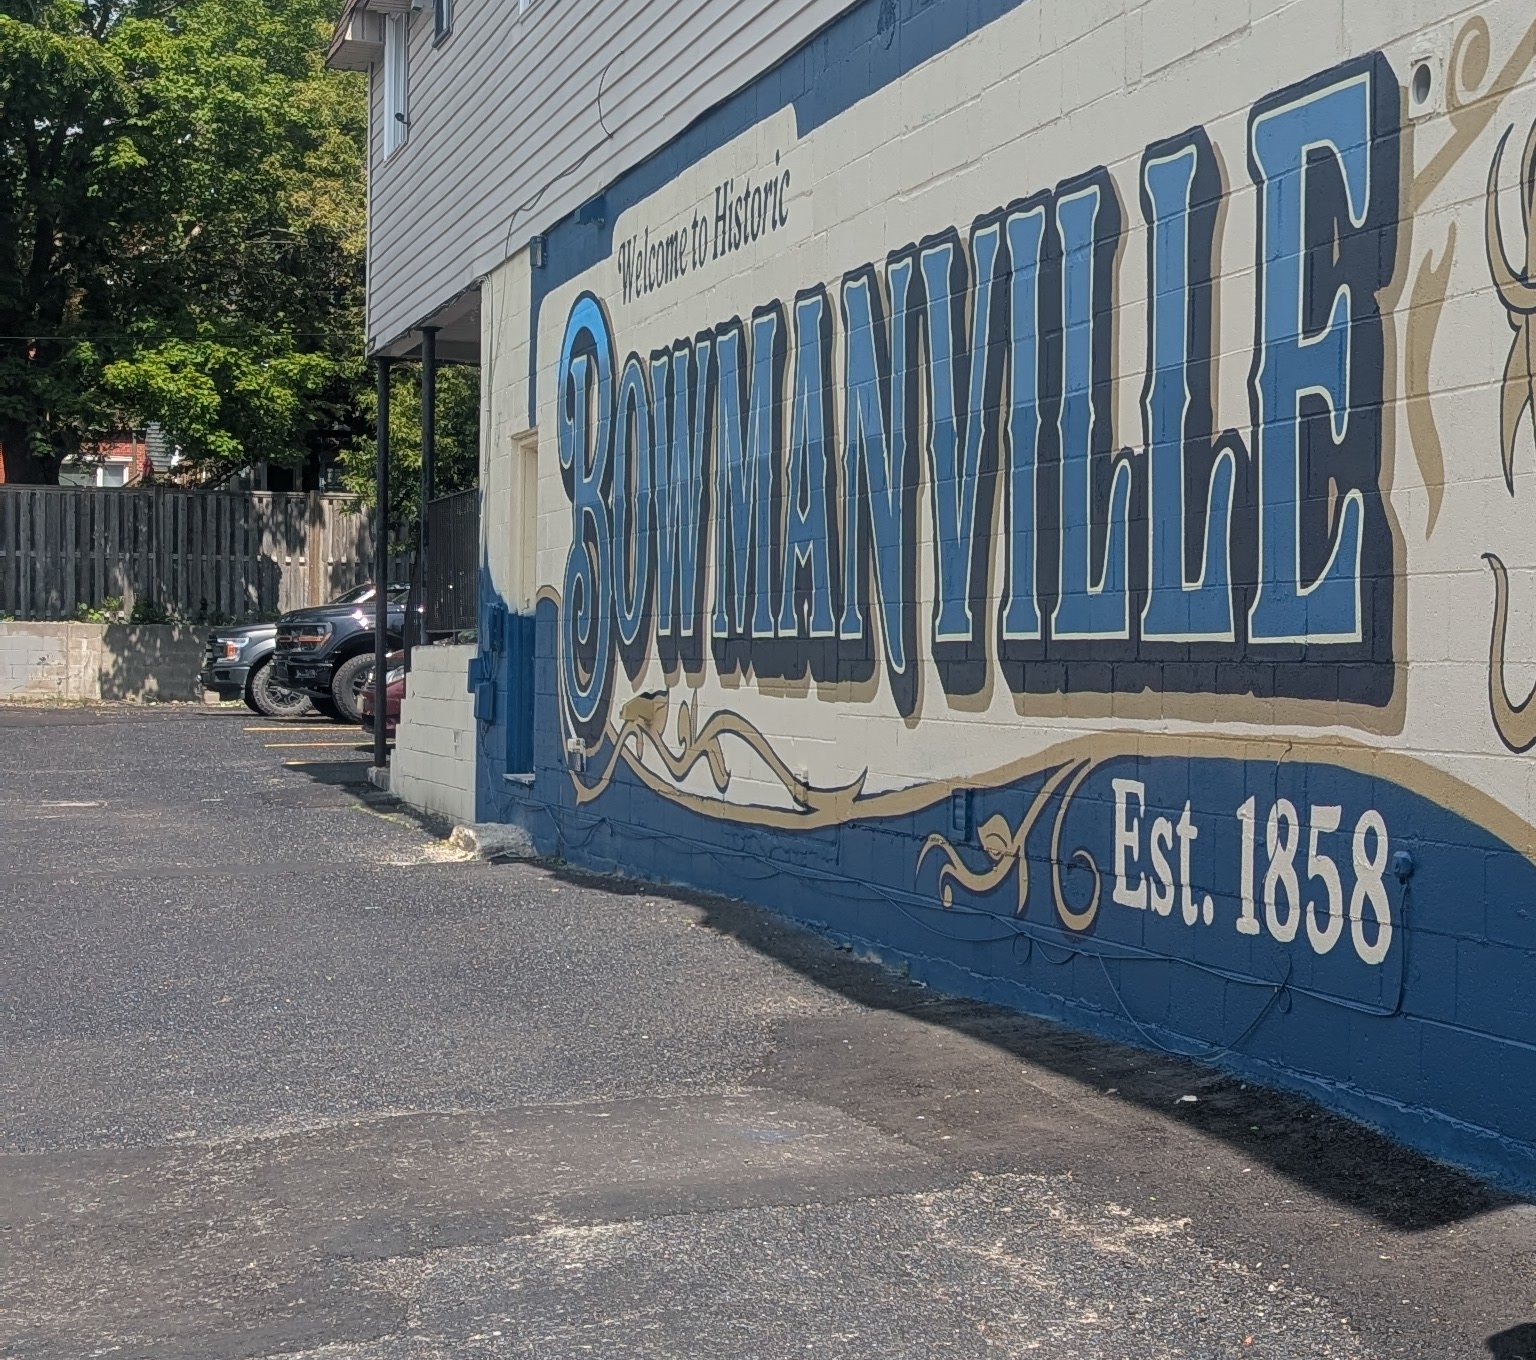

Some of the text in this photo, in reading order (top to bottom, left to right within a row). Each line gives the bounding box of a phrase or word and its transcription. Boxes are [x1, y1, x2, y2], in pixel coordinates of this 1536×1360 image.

[617, 149, 791, 305] Welcome to Historic
[556, 50, 1405, 745] BOWMANVILLE
[1111, 777, 1392, 965] Est. 1858
